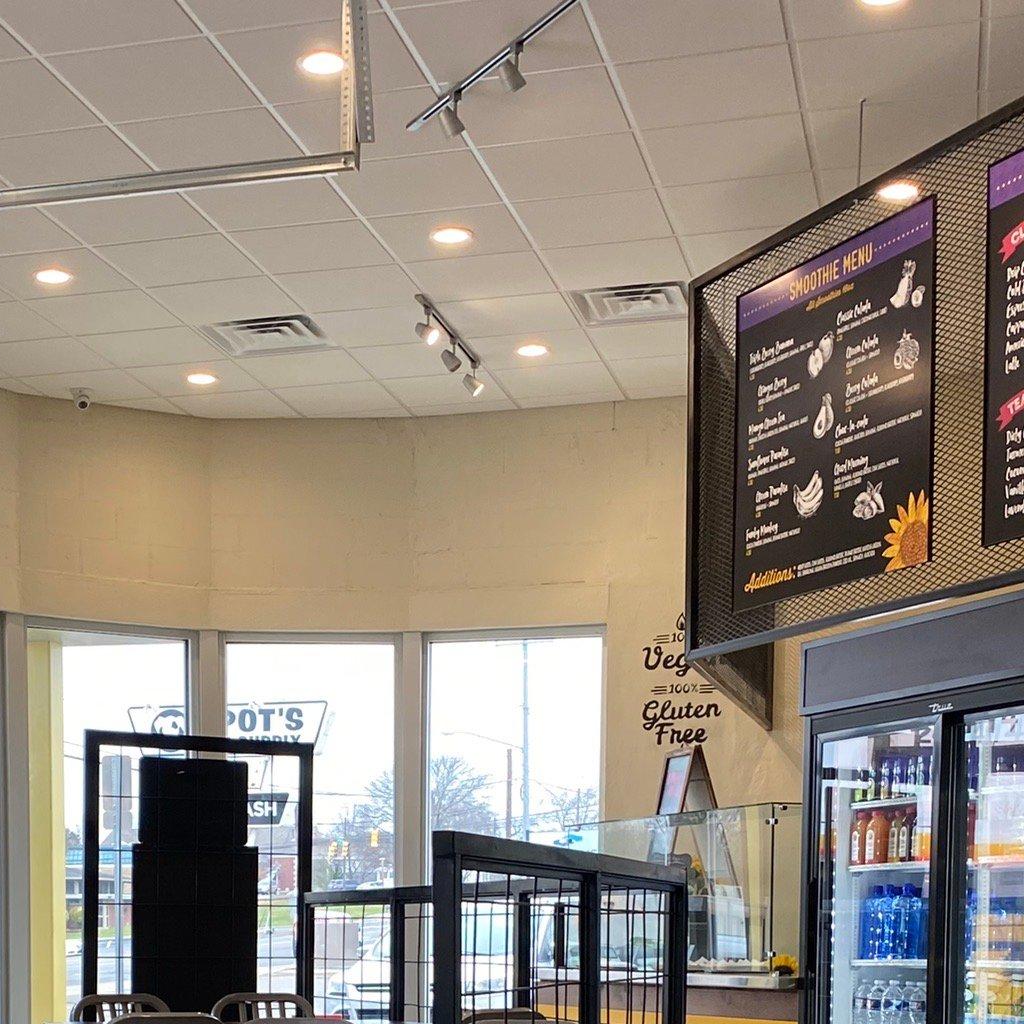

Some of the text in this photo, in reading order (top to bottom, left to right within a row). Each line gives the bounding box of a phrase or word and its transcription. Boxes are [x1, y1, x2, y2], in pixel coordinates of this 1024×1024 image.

[789, 242, 874, 301] SMOOTHIE MENU
[744, 565, 797, 593] Additions:
[642, 645, 691, 677] Veg
[668, 682, 699, 695] 100%
[226, 707, 304, 732] POT'S
[642, 700, 722, 731] Gluten
[928, 702, 954, 713] True
[655, 723, 708, 746] Free
[247, 800, 278, 818] ASH
